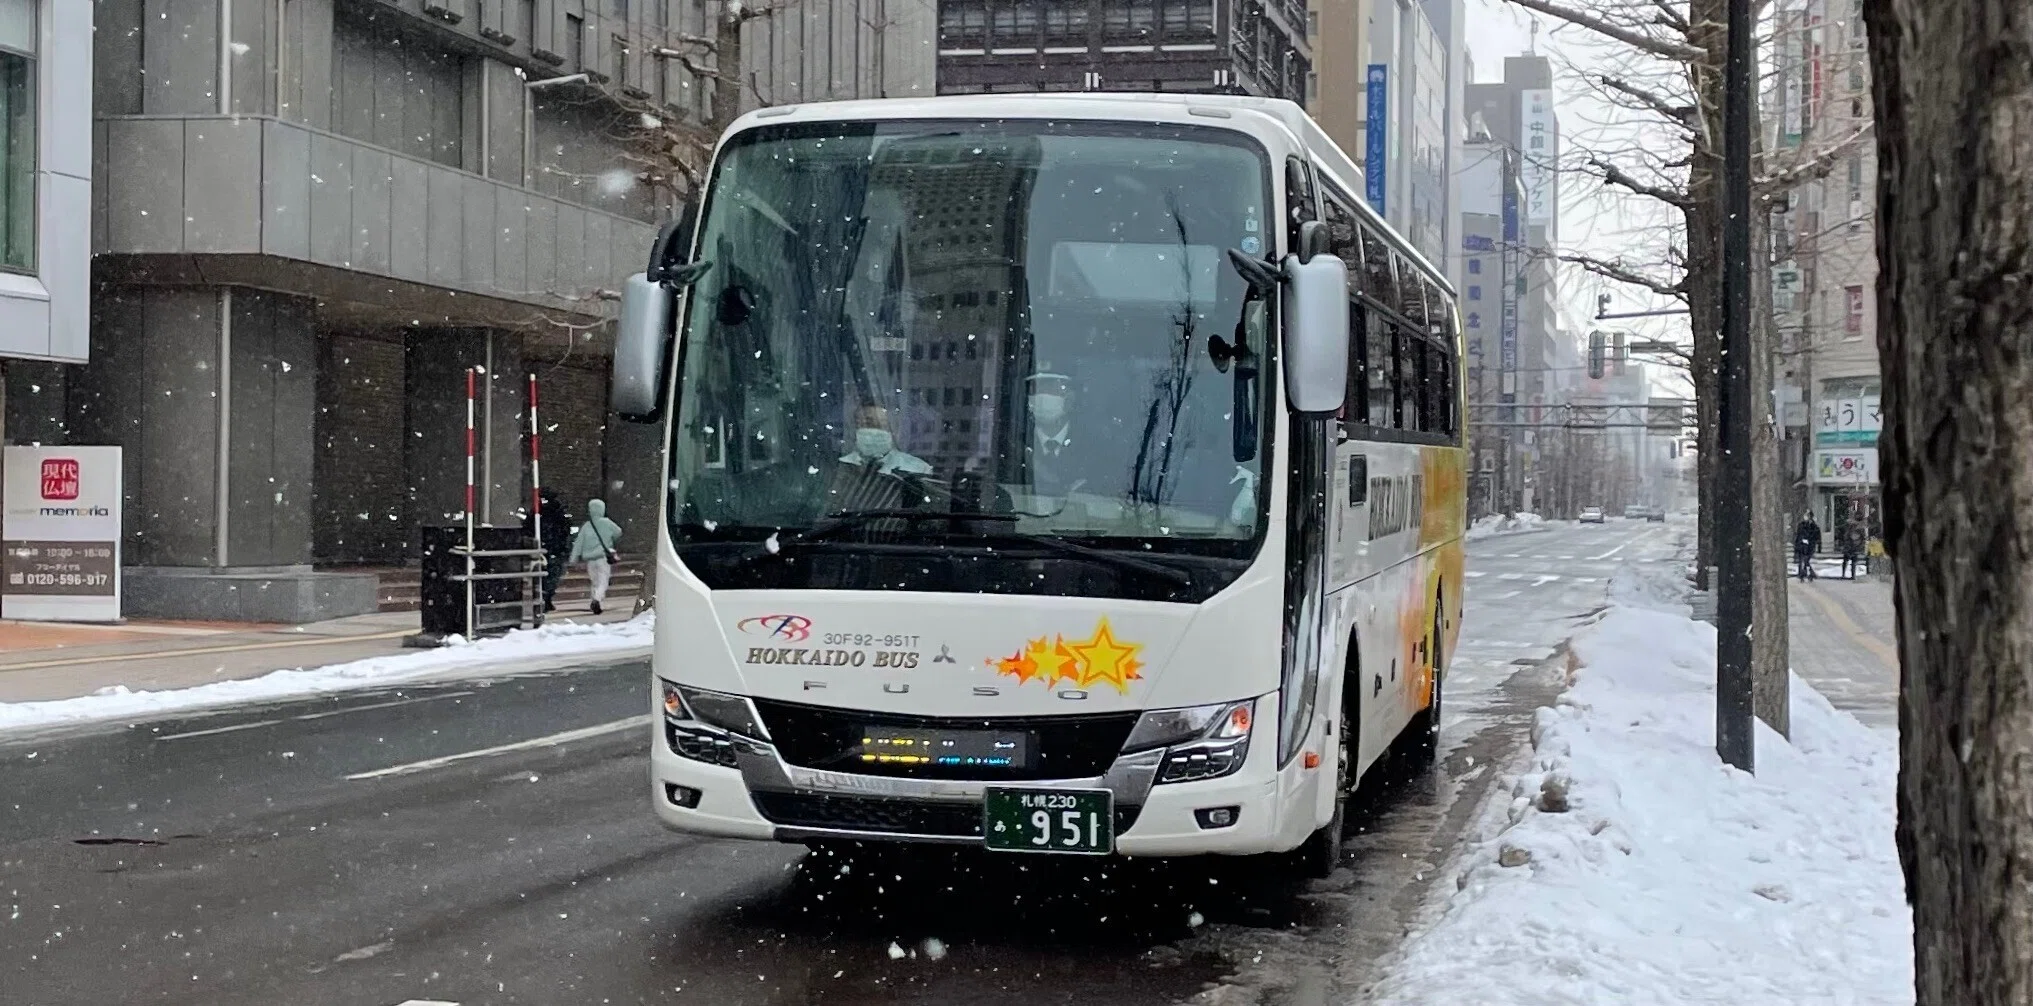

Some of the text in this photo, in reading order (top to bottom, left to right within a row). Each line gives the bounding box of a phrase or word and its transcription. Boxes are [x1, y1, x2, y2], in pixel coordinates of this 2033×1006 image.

[43, 463, 77, 479] 現代
[43, 480, 77, 496] 仏壇
[40, 504, 109, 516] memoria
[823, 632, 920, 648] 30F92-951T
[746, 648, 920, 668] HOKKAIDO BUS
[803, 680, 1088, 700] FUSO
[1031, 810, 1098, 847] 951
